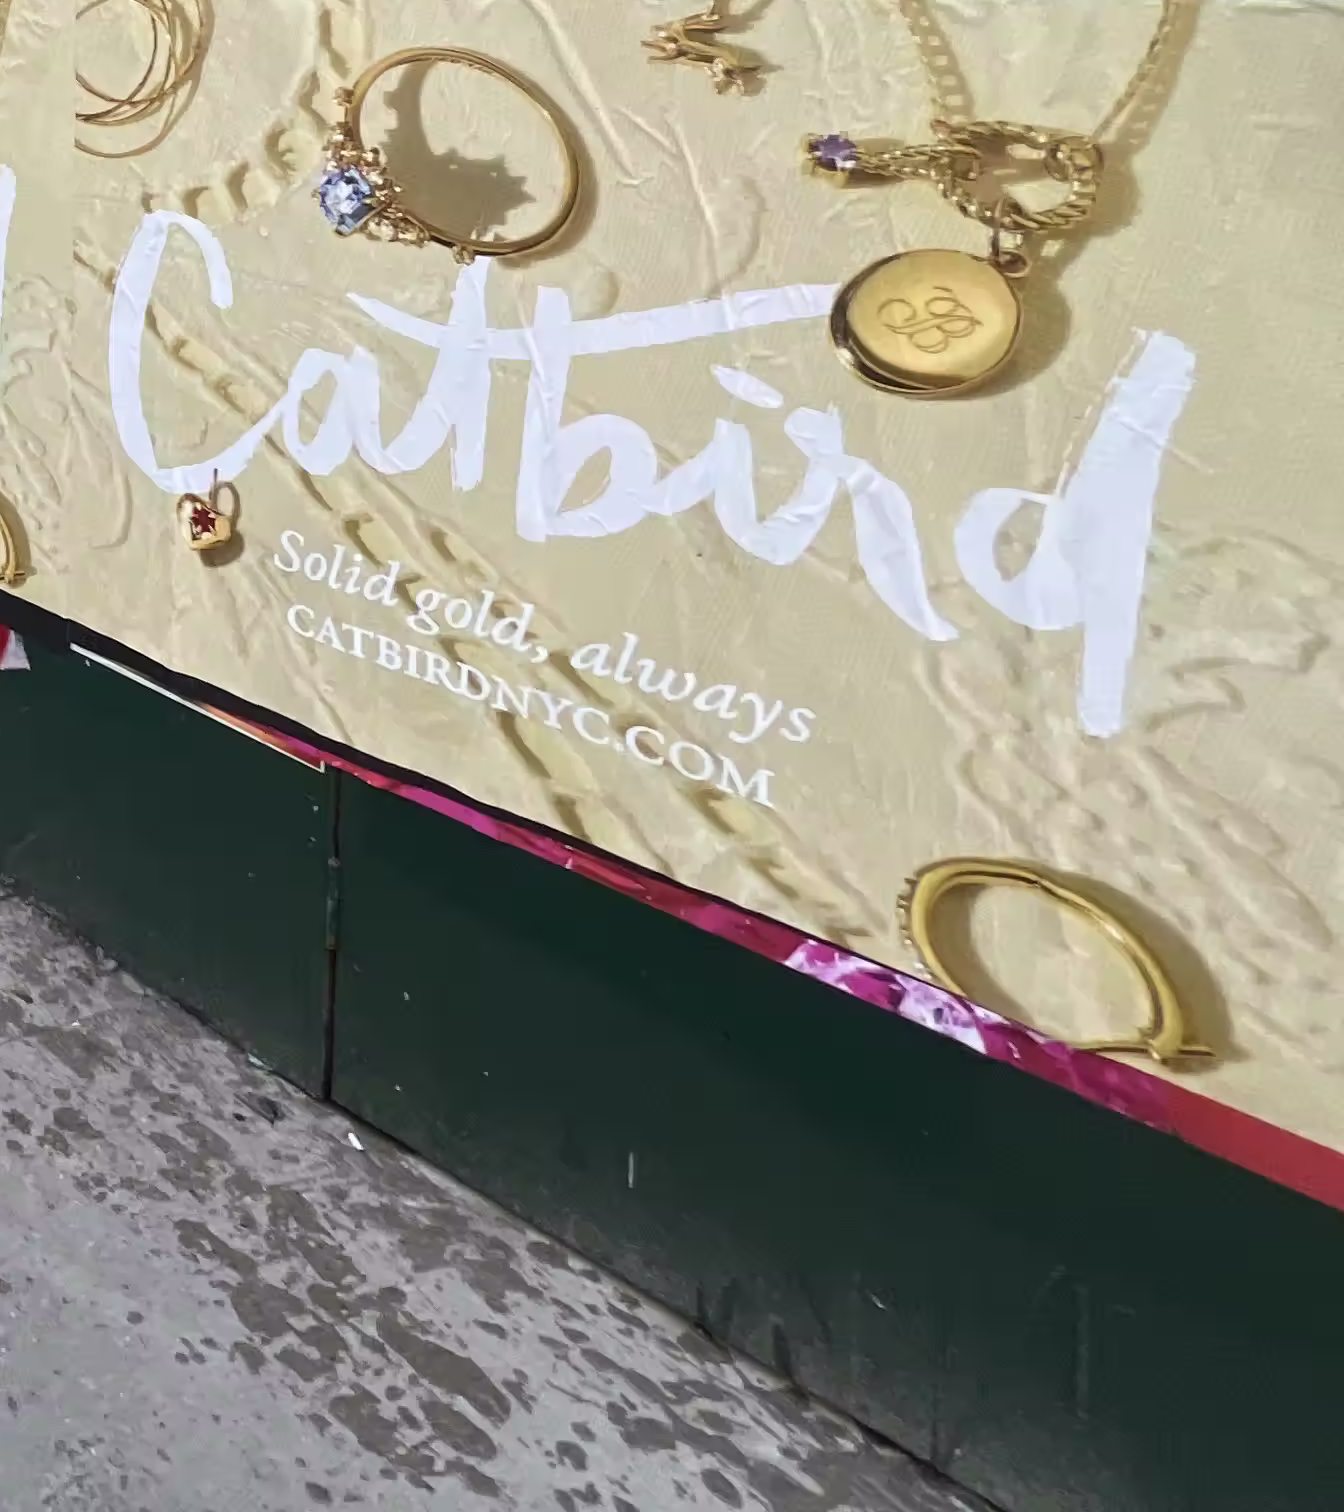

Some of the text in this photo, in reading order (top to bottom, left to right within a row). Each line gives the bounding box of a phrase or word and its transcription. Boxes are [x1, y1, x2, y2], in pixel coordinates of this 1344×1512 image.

[108, 207, 1199, 737] Catbird
[273, 529, 817, 745] Solid gold, always
[286, 603, 776, 810] CATBIRDNYC.COM
